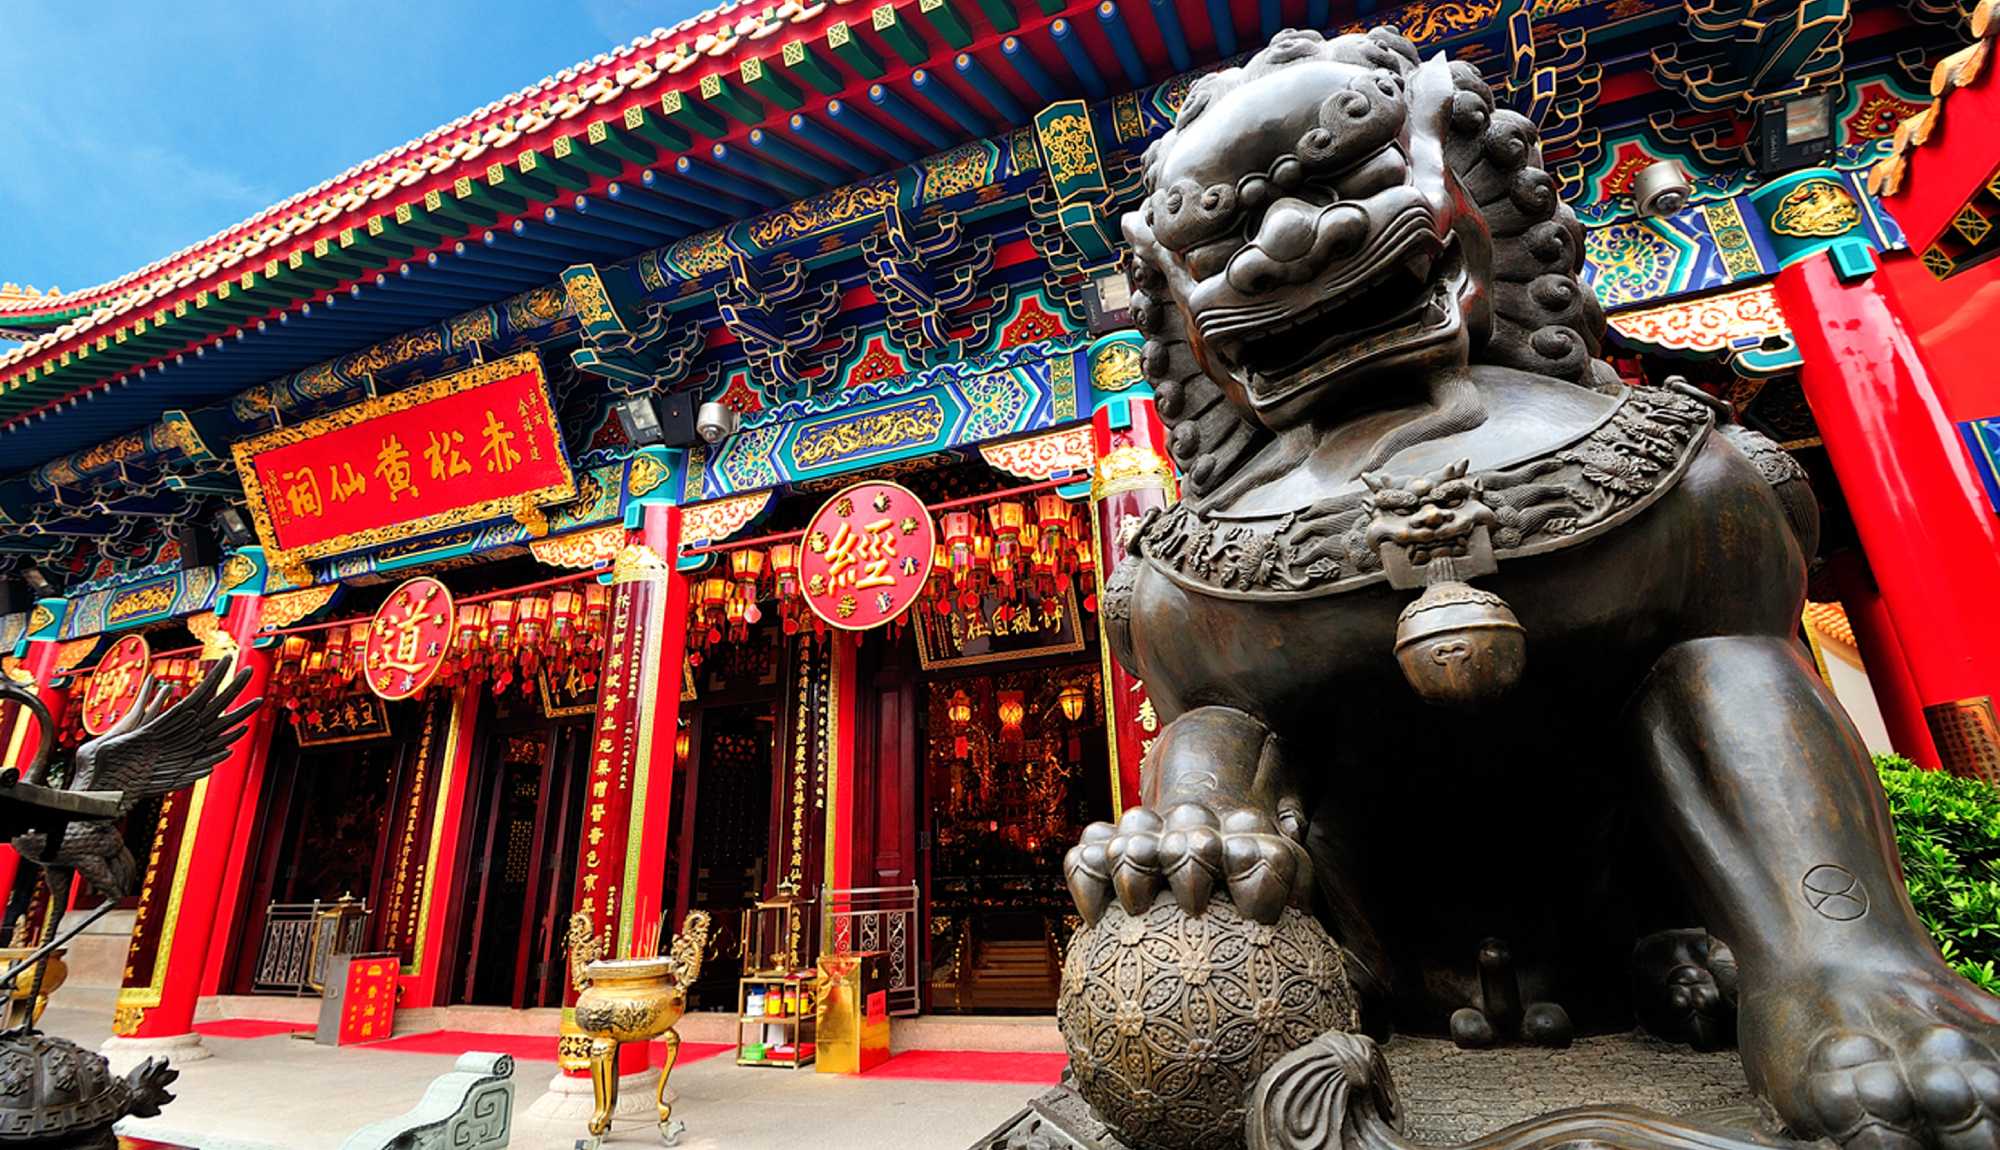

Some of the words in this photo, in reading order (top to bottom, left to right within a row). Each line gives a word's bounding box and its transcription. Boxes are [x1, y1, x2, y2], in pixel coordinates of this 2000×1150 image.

[824, 518, 897, 597] 經
[379, 599, 430, 674] 道
[95, 657, 135, 712] 師
